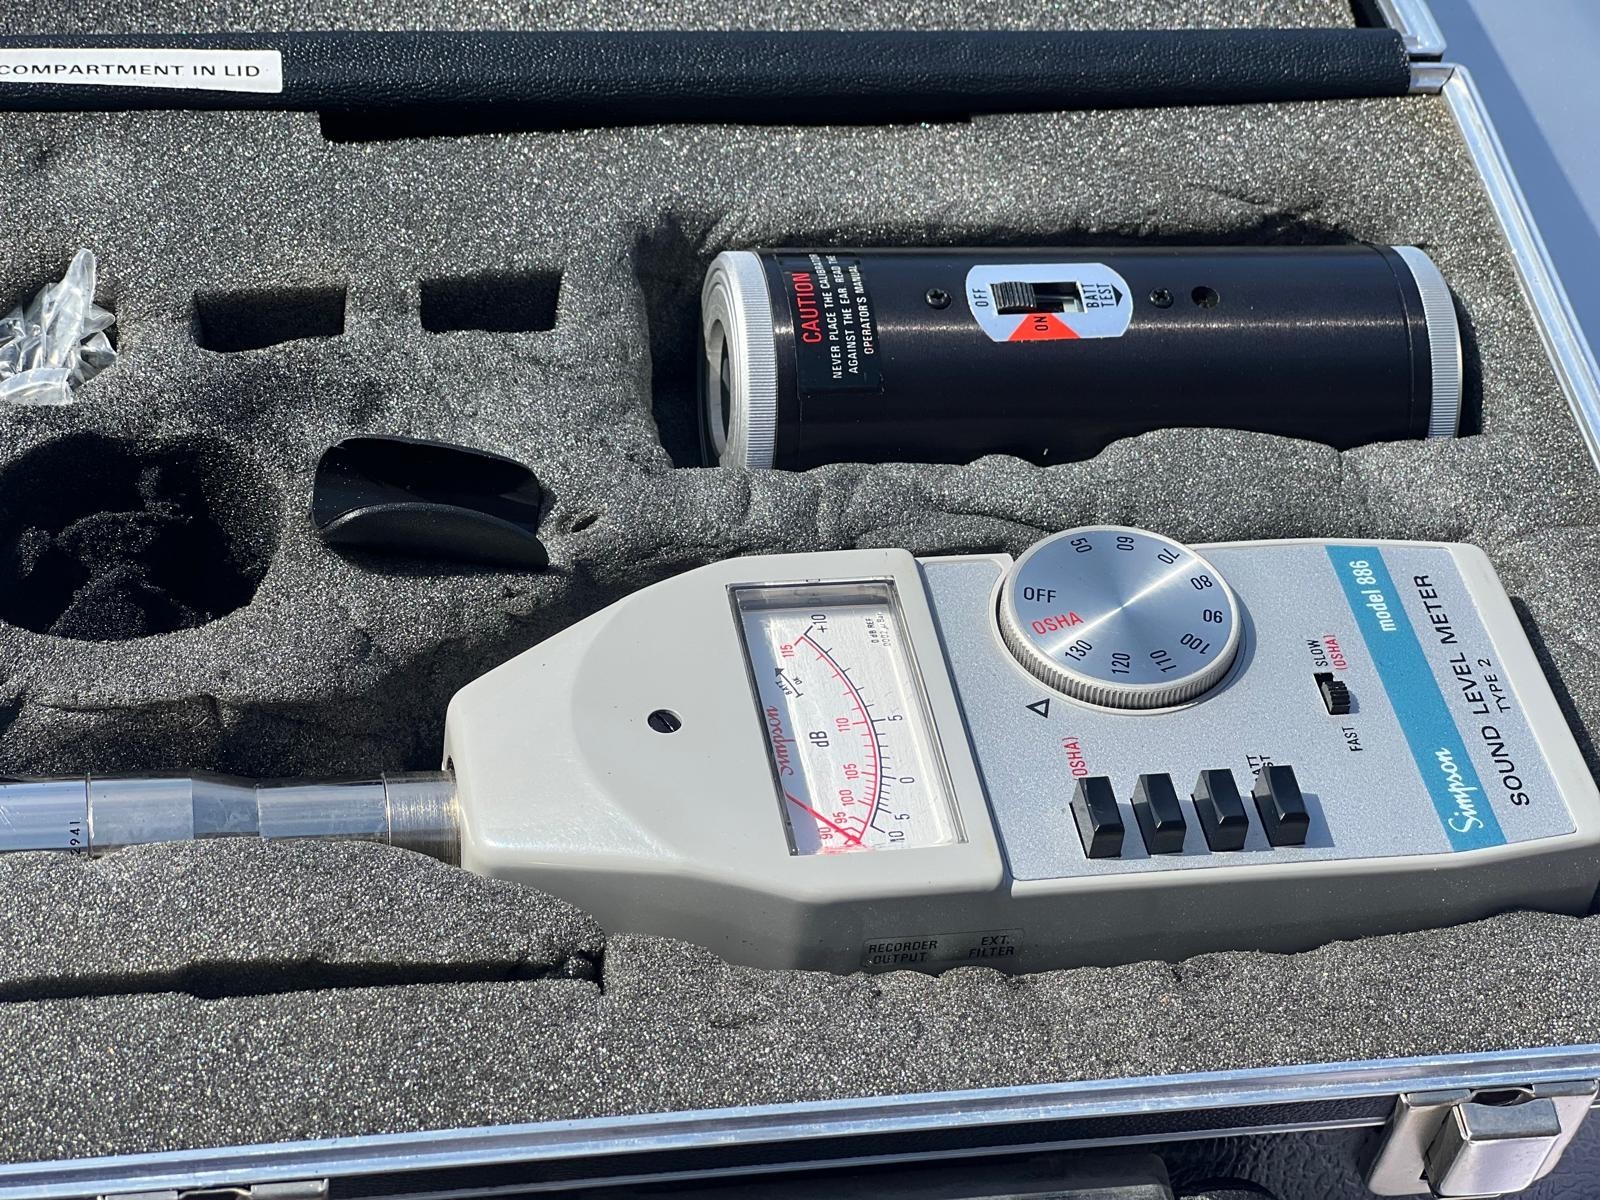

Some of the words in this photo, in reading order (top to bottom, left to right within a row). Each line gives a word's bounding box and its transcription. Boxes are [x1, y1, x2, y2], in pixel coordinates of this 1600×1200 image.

[0, 64, 184, 77] COMPARTMENT
[193, 66, 216, 76] IN
[224, 65, 261, 77] LID
[831, 265, 844, 282] READ
[848, 265, 864, 294] MANUAL
[822, 291, 834, 308] THE
[838, 287, 850, 304] EAR
[972, 288, 989, 307] OFF
[1081, 283, 1100, 309] BATT
[1096, 283, 1115, 308] TEST
[792, 272, 822, 343] CAUTION
[842, 308, 853, 325] THE
[826, 312, 839, 340] PLACE
[856, 296, 874, 354] OPERATOR'S
[1034, 316, 1049, 331] ON
[845, 330, 858, 374] AGAINST
[830, 345, 843, 379] NEVER
[1070, 537, 1093, 553] 50
[1116, 536, 1134, 551] 60
[1157, 548, 1181, 565] 70
[1349, 560, 1376, 586] 886
[1190, 575, 1213, 590] 80
[1023, 586, 1057, 603] OFF
[1361, 588, 1396, 632] model
[1413, 575, 1458, 644] METER
[1031, 612, 1084, 635] OSHA
[780, 644, 794, 658] 115
[1065, 639, 1093, 661] 130
[1180, 633, 1211, 655] 100
[1307, 639, 1328, 667] SLOW
[1112, 652, 1131, 675] 120
[1149, 649, 1177, 673] 110
[1477, 658, 1492, 668] 2
[775, 680, 792, 696] BATT
[1449, 652, 1490, 714] LEVEL
[1484, 673, 1511, 713] TYPE
[836, 717, 850, 732] 110
[888, 714, 903, 722] 5
[766, 706, 795, 776] Simpson
[809, 731, 830, 748] dB
[1342, 726, 1363, 752] FAST
[843, 763, 860, 779] 105
[1245, 754, 1261, 782] ATT
[1481, 725, 1530, 806] SOUND
[899, 776, 915, 784] 0
[839, 789, 855, 807] 100
[1434, 747, 1484, 833] Simpson
[833, 812, 848, 824] 95
[819, 827, 833, 840] 90
[888, 831, 905, 842] 10
[868, 940, 938, 954] RECORDER
[968, 946, 1015, 959] FILTER
[873, 952, 927, 965] OUTPUT
